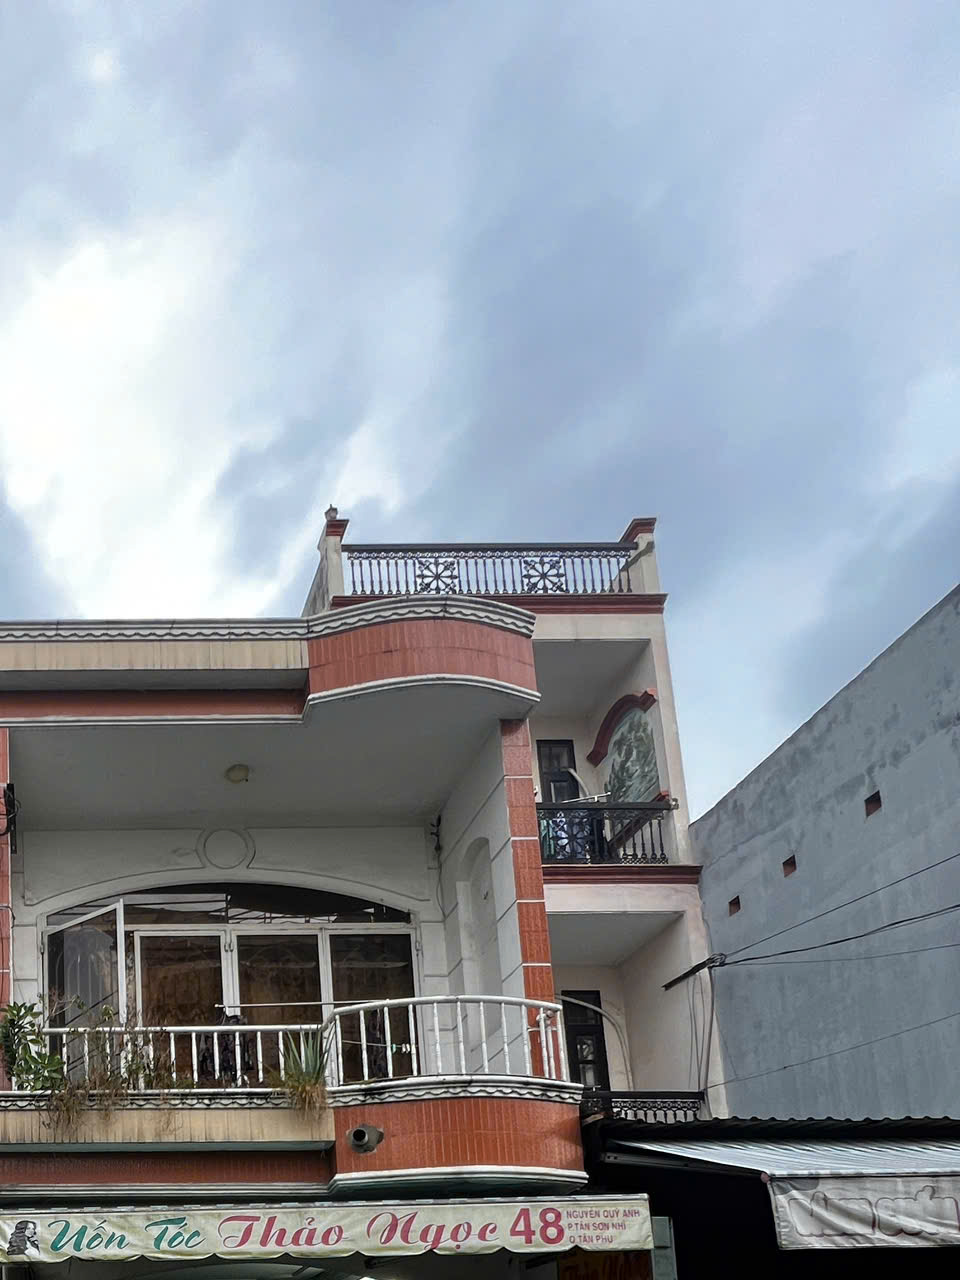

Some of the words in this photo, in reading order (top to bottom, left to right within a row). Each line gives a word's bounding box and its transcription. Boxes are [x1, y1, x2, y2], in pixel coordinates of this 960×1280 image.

[623, 1210, 640, 1218] ANH
[48, 1219, 130, 1252] Uốn
[144, 1217, 206, 1250] Tóc
[218, 1215, 349, 1248] Thảo
[367, 1211, 499, 1250] Ngọc
[509, 1208, 565, 1244] 48
